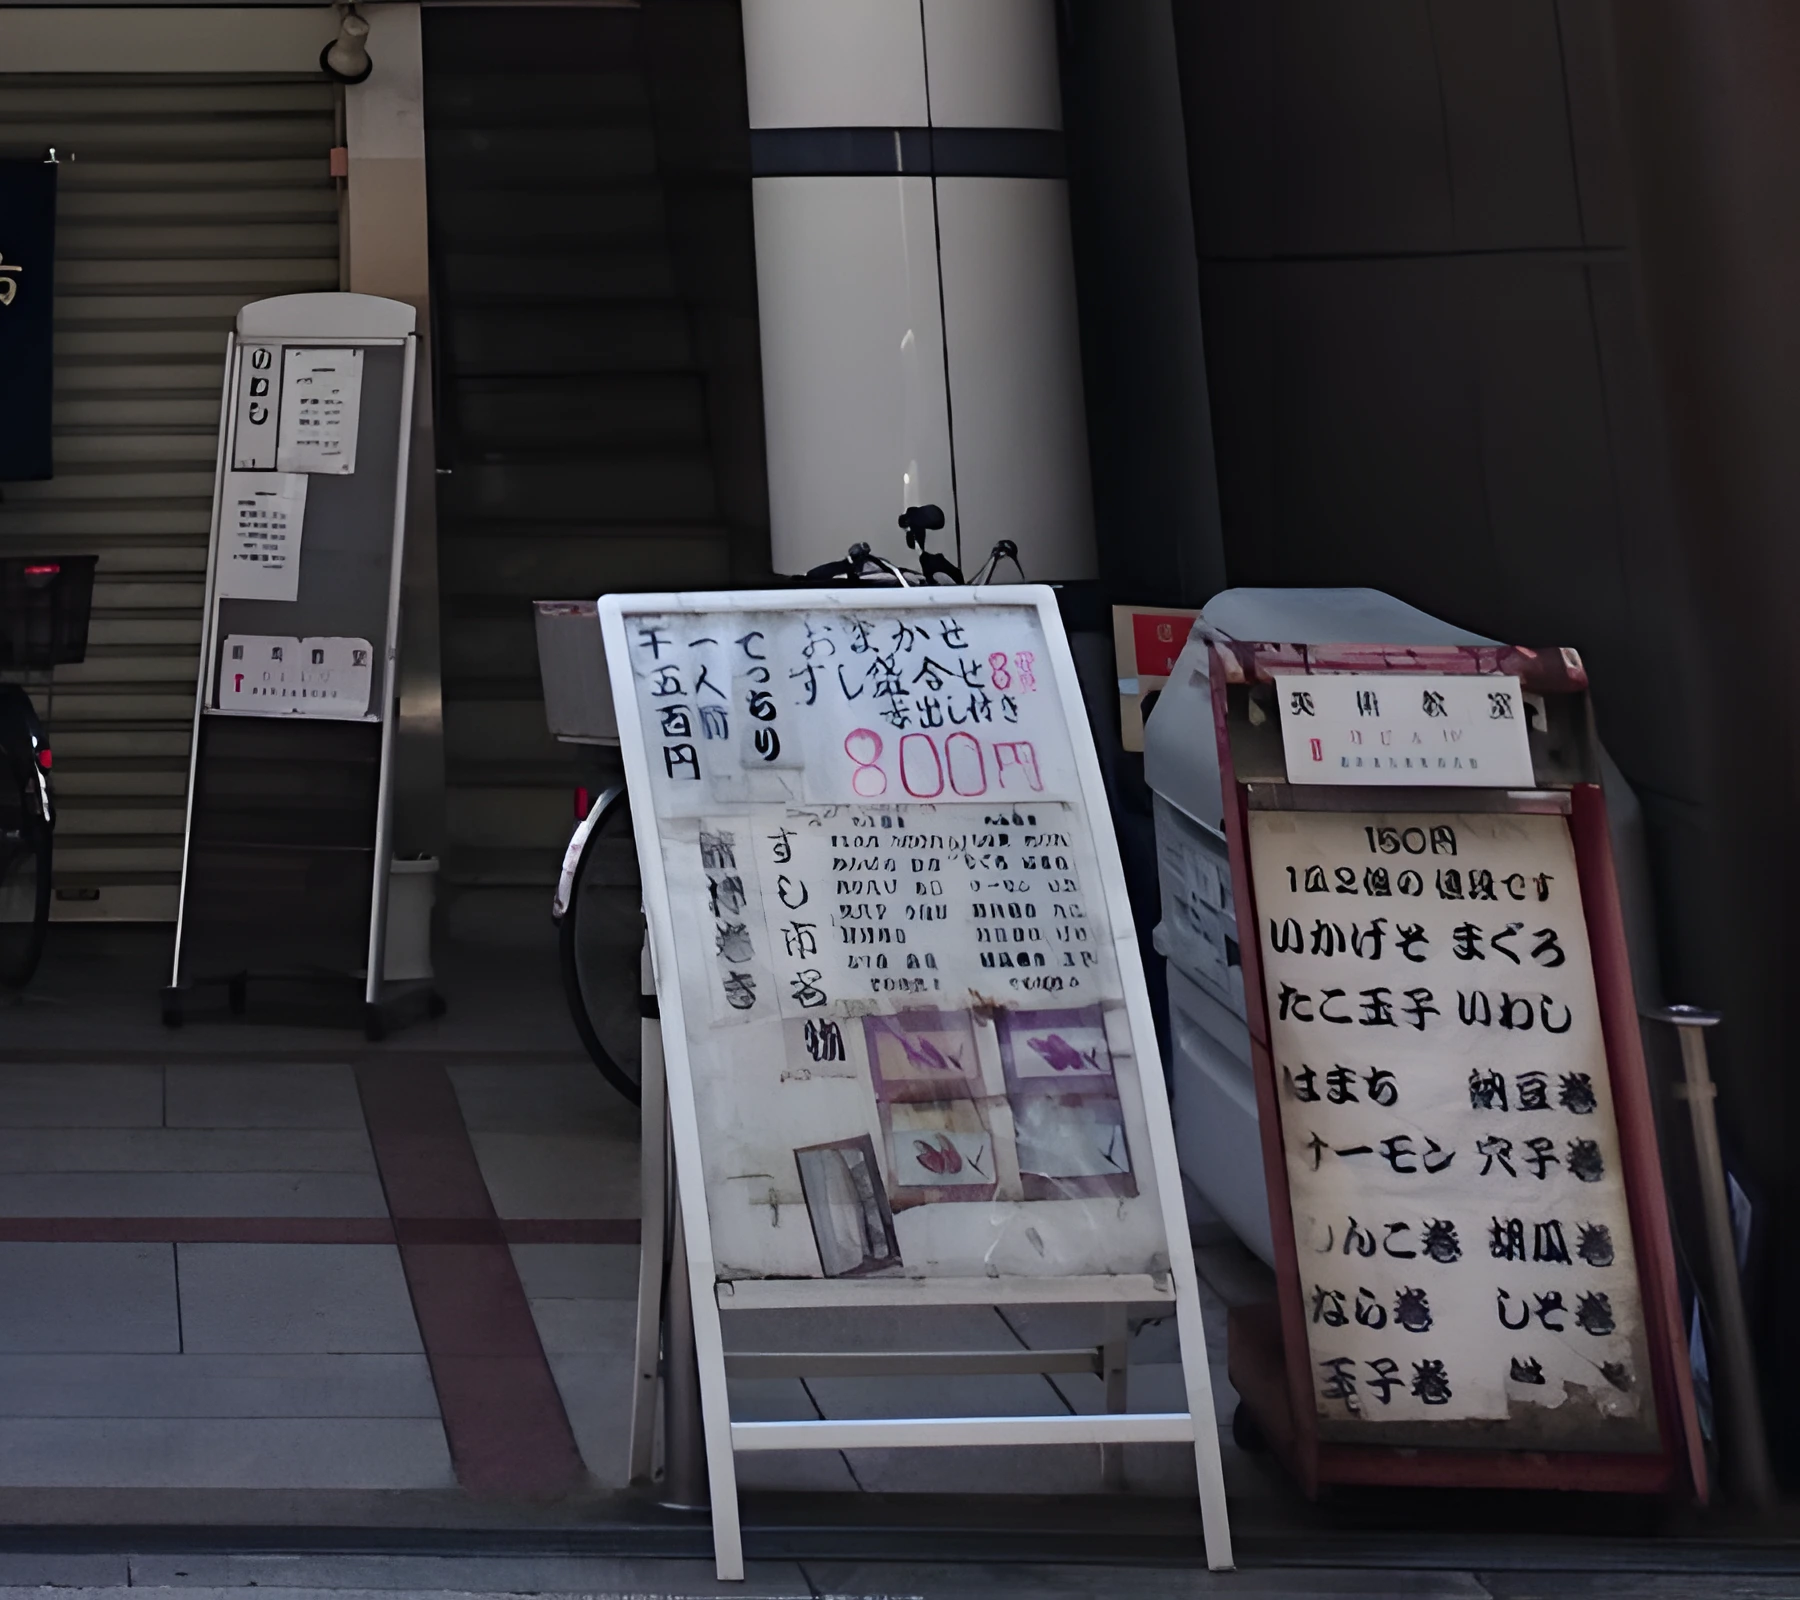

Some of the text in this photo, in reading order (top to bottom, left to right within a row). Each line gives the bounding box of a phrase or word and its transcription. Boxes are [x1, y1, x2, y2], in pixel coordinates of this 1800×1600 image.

[801, 615, 969, 659] おまかせ
[843, 726, 1044, 800] 800円
[1270, 916, 1567, 968] いかげそ まぐろ
[1456, 990, 1573, 1034] いわし
[1282, 1063, 1400, 1107] はまち
